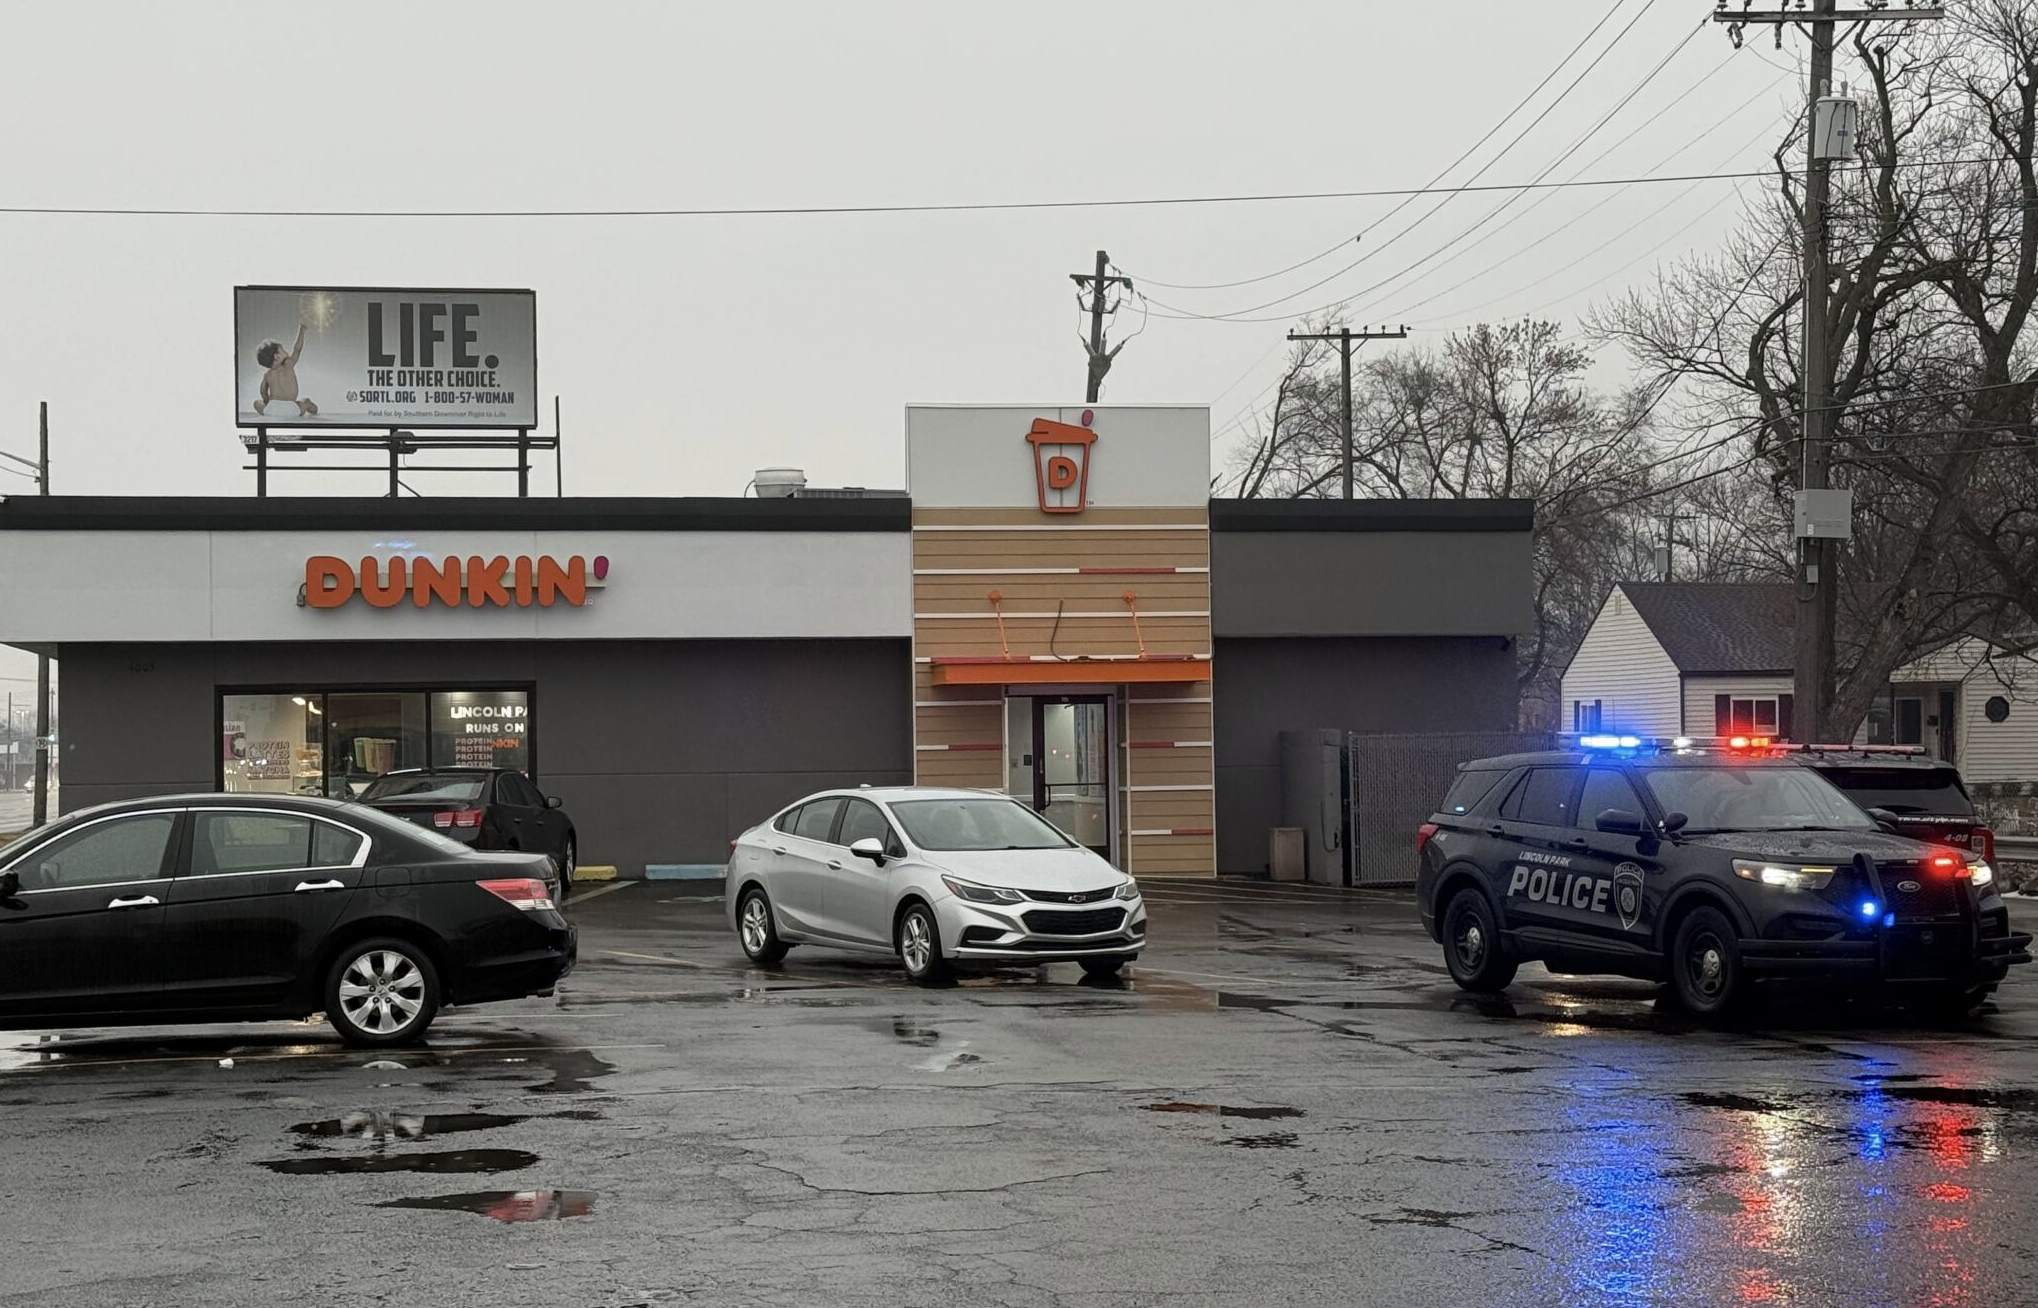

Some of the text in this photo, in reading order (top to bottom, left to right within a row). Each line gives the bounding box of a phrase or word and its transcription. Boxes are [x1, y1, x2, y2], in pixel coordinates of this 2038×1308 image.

[368, 302, 499, 369] LIFE.
[367, 370, 500, 387] THE OTHER CHOICE.
[360, 391, 514, 404] SORTL.ORG 1-800-57-WOMAN
[1048, 456, 1078, 490] D
[306, 555, 609, 608] DUNKIN'
[451, 706, 512, 718] LINCOLN
[466, 723, 524, 733] RUNS ON
[456, 737, 492, 745] PROTEIN
[456, 745, 492, 753] PROTEIN
[1519, 851, 1573, 867] LINCOLN PARK
[1507, 865, 1612, 913] POLICE
